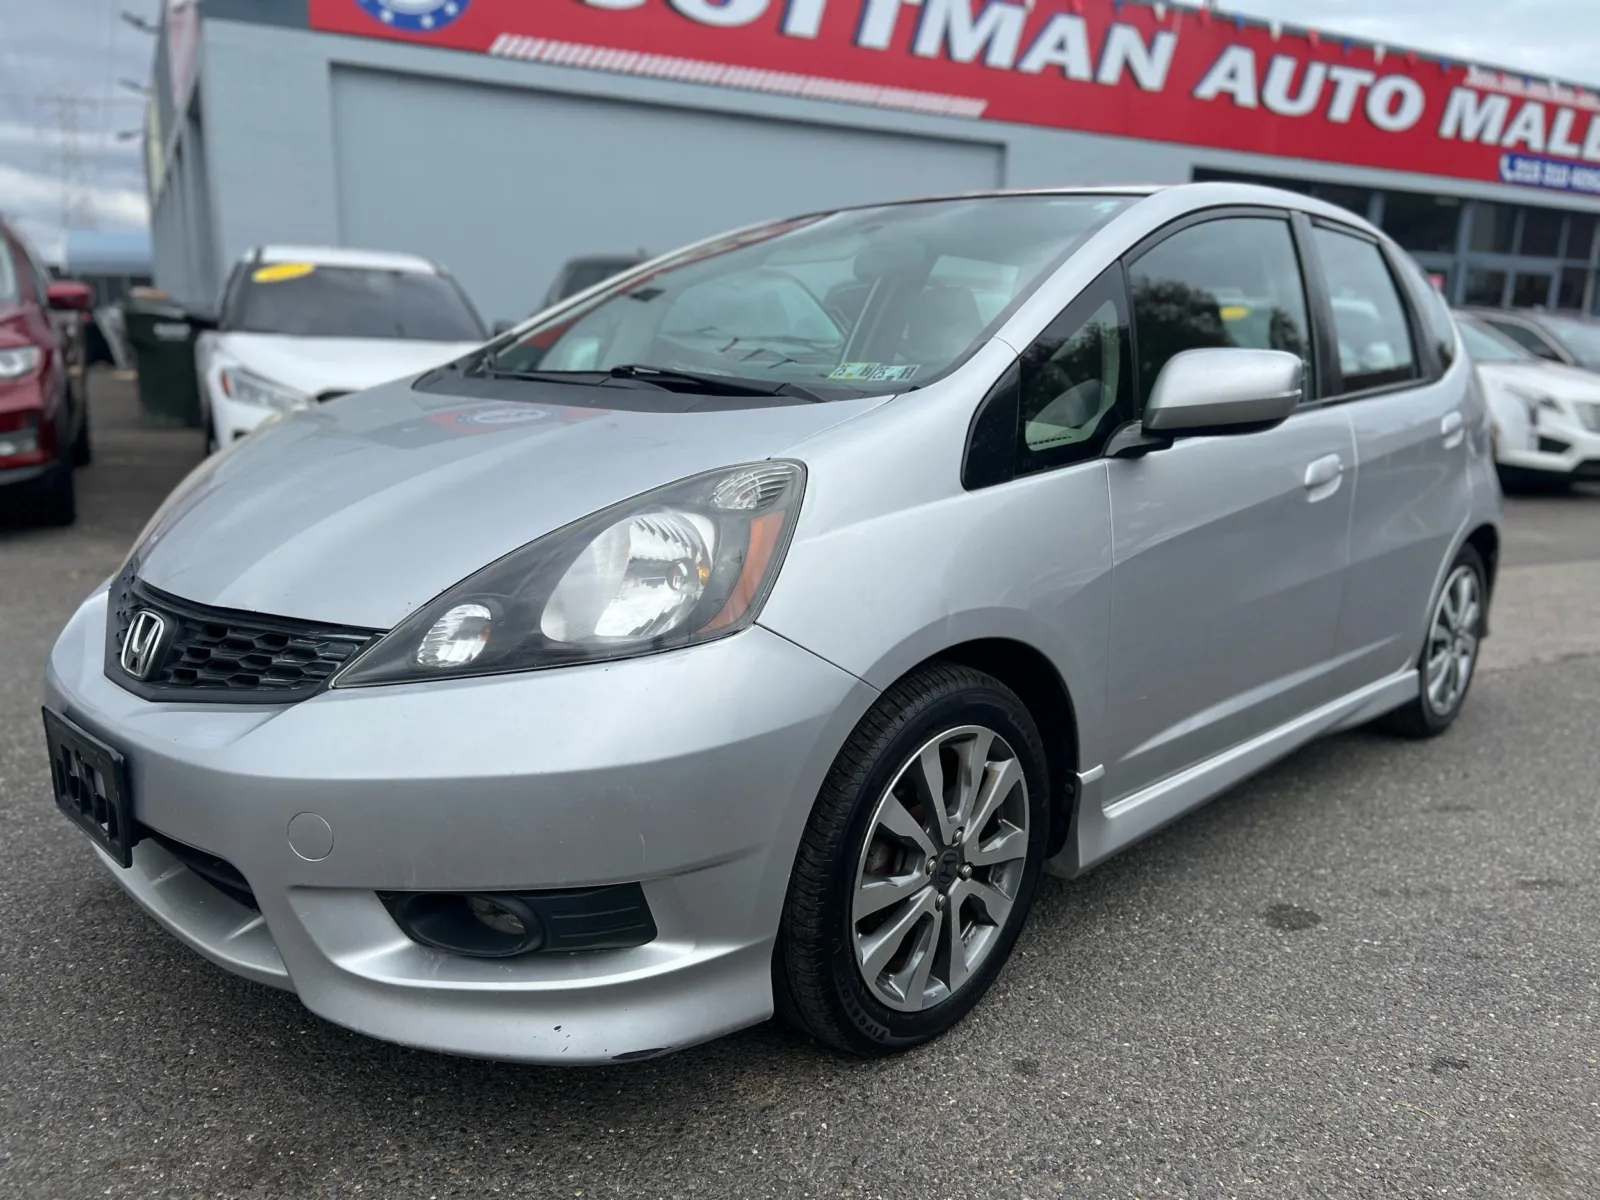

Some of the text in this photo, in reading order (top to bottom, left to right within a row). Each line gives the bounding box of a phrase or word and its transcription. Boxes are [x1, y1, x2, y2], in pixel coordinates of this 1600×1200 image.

[576, 0, 1176, 91] TMAN
[1192, 43, 1425, 132] AUTO
[836, 957, 888, 1040] Firesto
